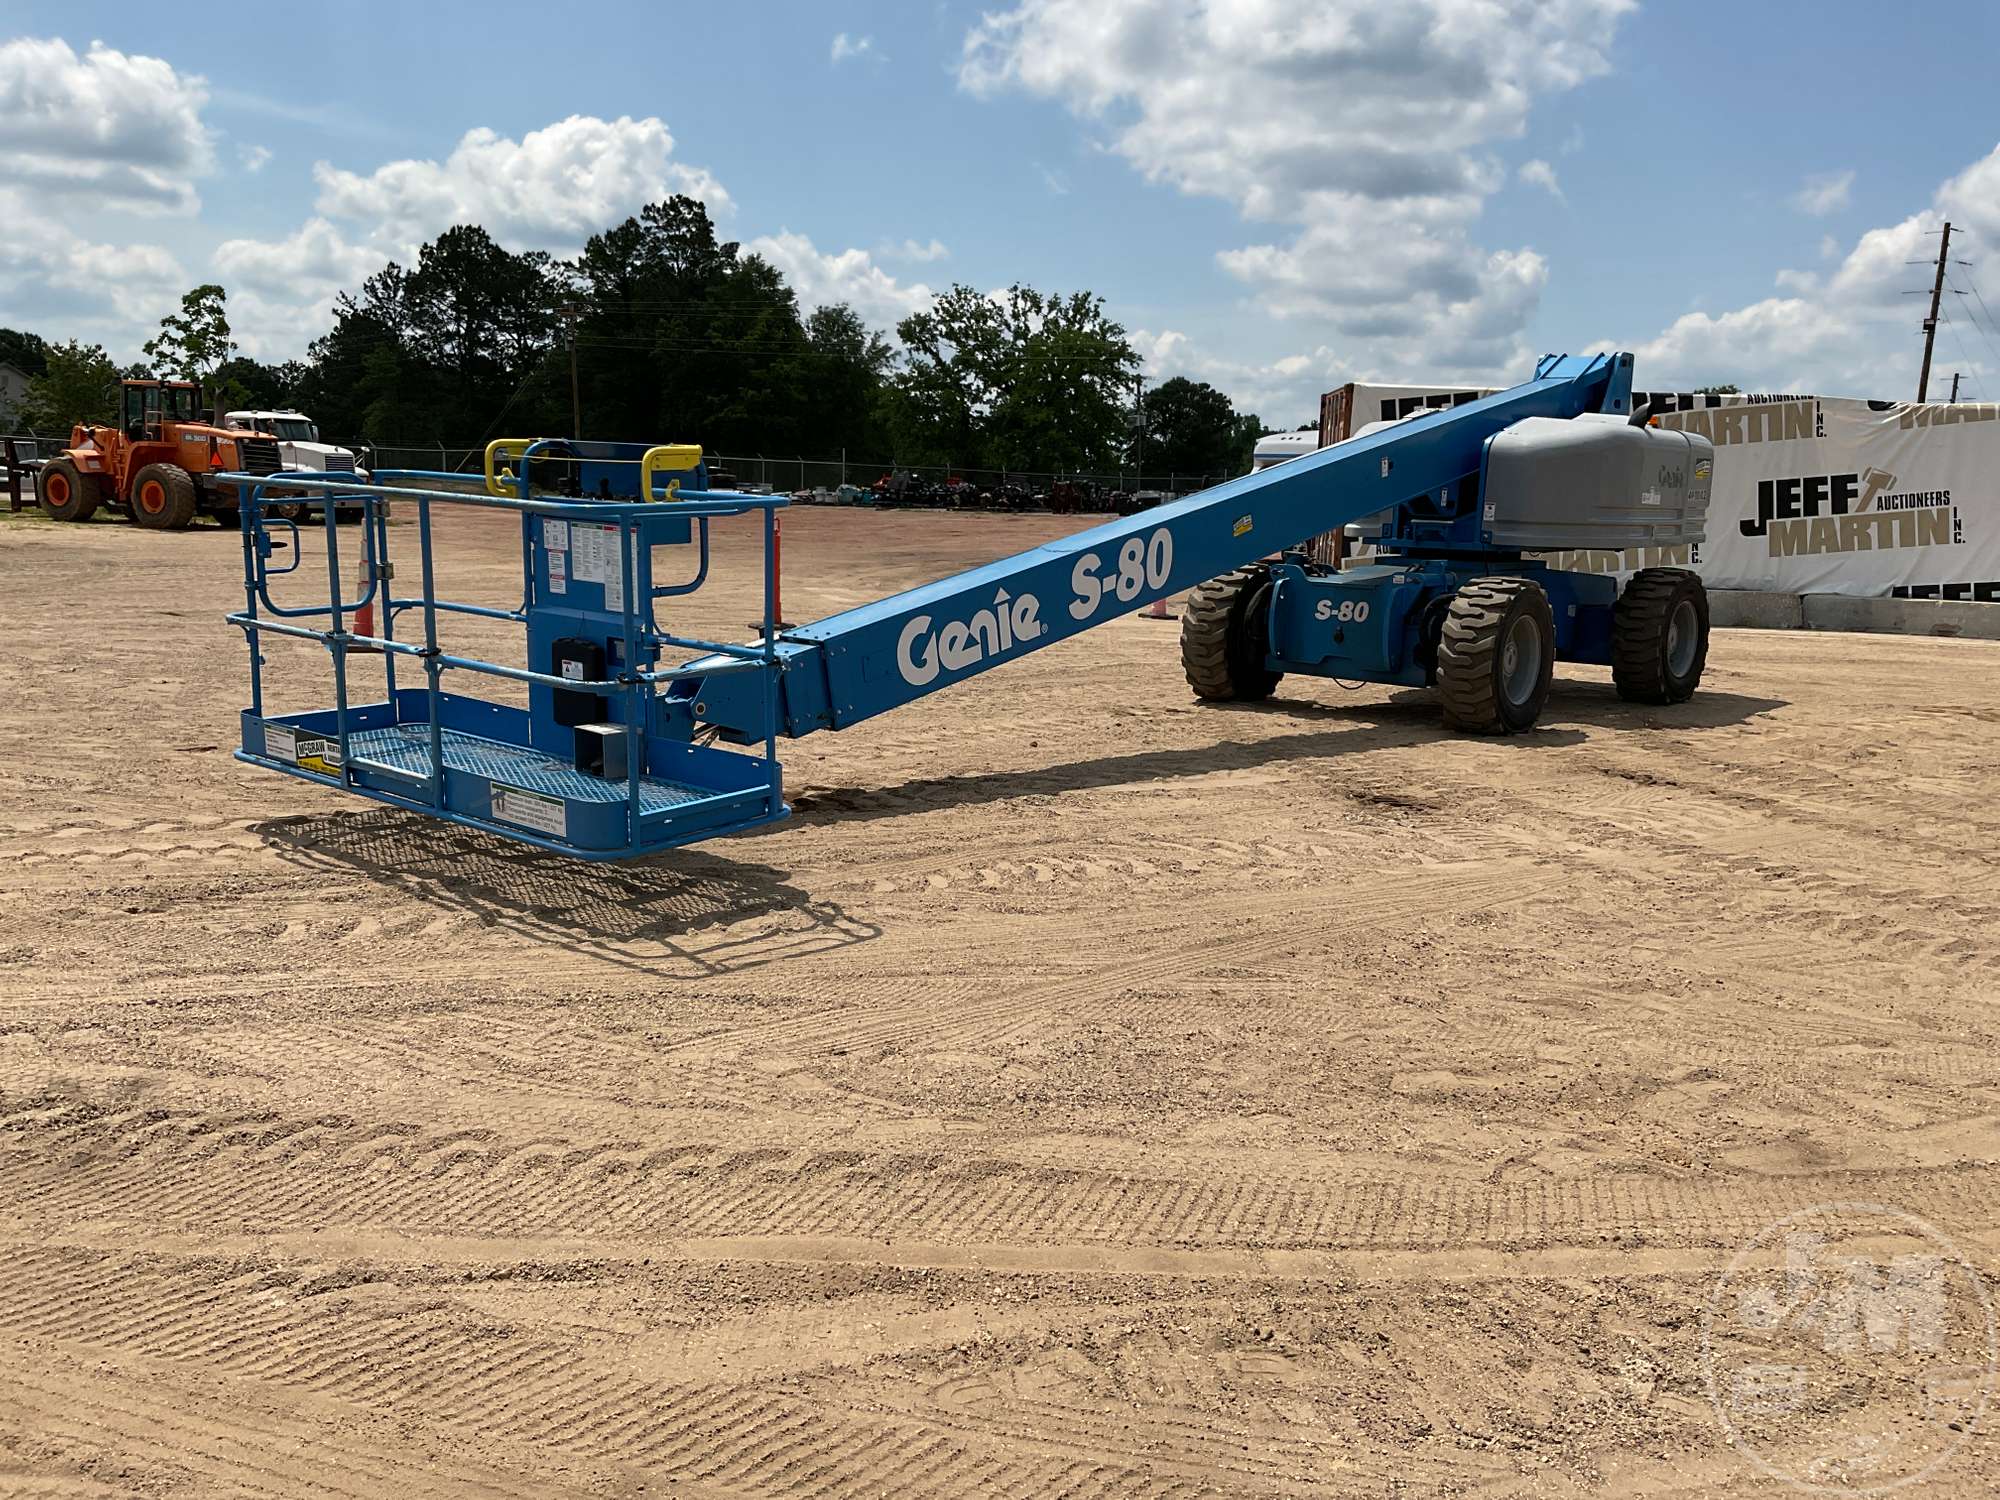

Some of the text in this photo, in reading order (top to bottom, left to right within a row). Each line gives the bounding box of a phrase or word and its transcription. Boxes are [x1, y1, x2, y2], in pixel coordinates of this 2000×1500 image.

[1740, 474, 1859, 537] JEFF
[1877, 490, 1951, 511] AUCTIONEERS
[1768, 507, 1950, 558] MARTIN
[897, 528, 1173, 686] Genie S-80
[1314, 599, 1370, 623] S-80
